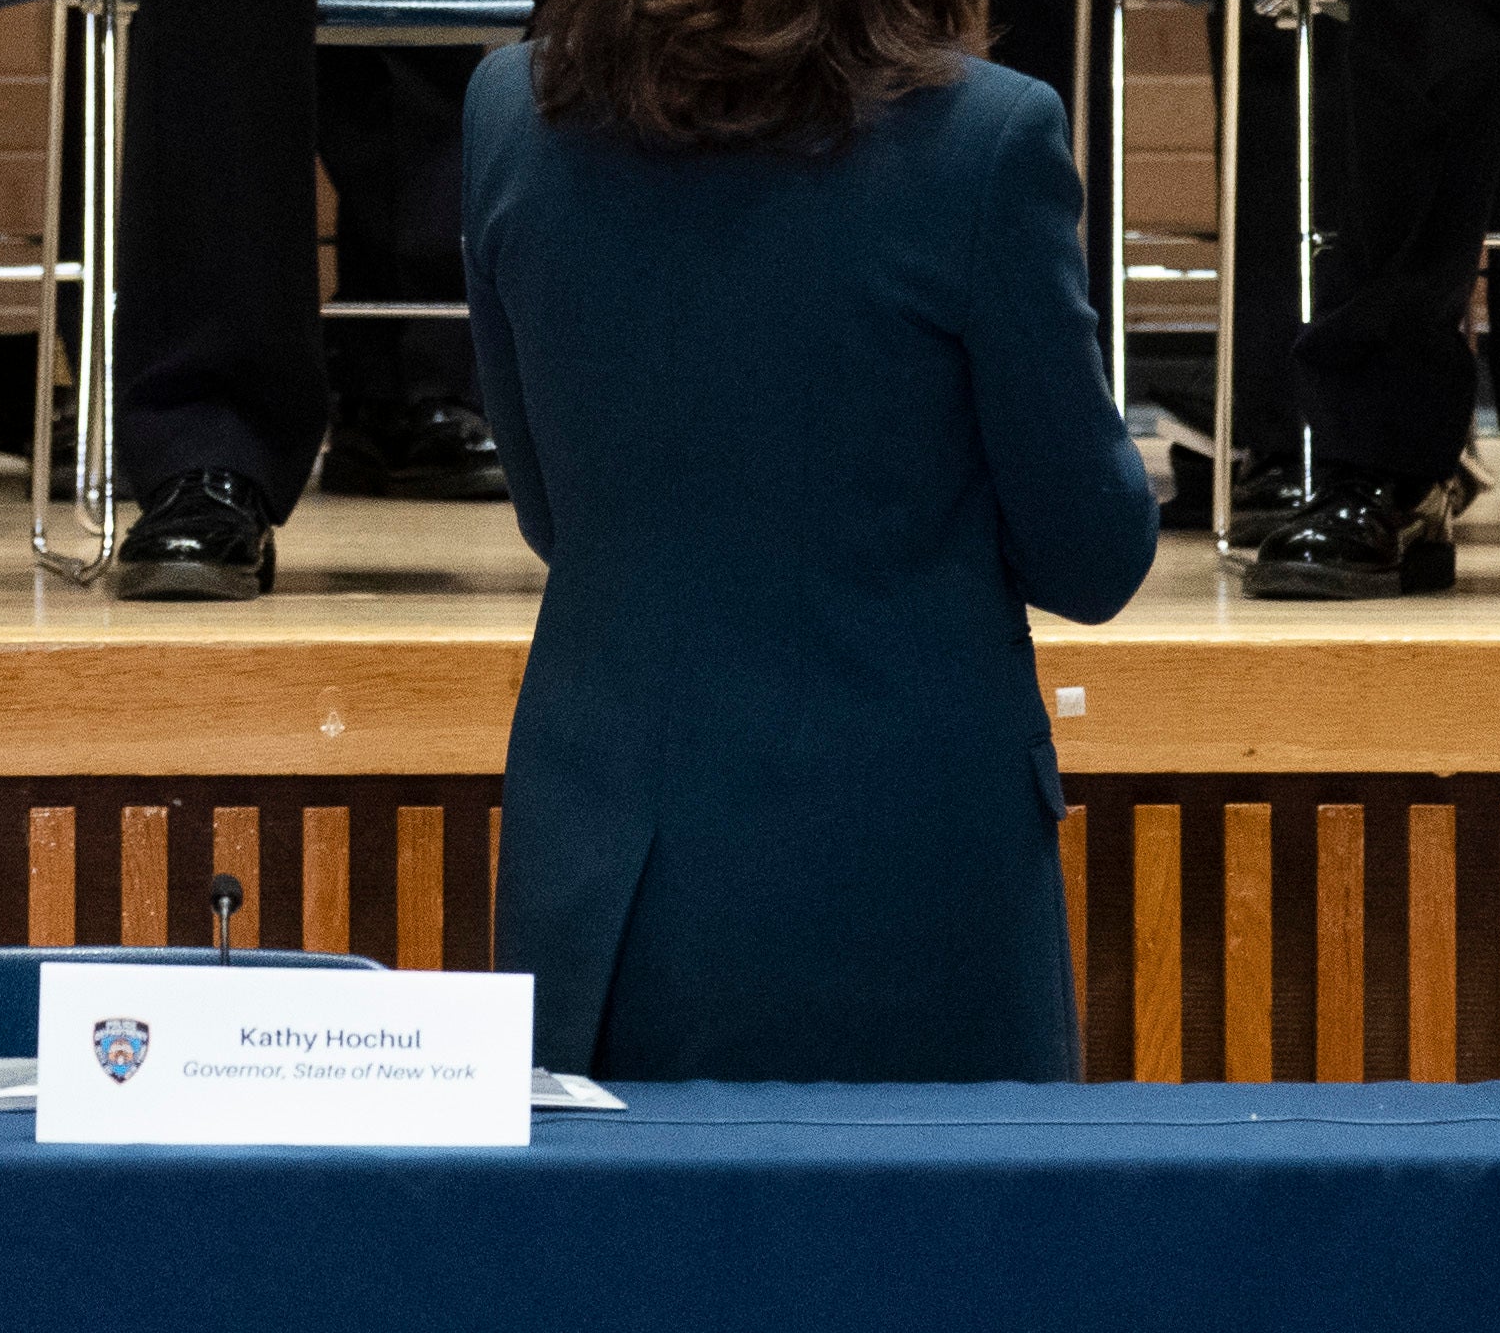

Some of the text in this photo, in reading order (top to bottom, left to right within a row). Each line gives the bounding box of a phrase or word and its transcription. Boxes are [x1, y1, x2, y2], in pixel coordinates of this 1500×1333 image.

[239, 1027, 421, 1053] Kathy Hochul
[182, 1059, 477, 1081] Governor, State of New York
